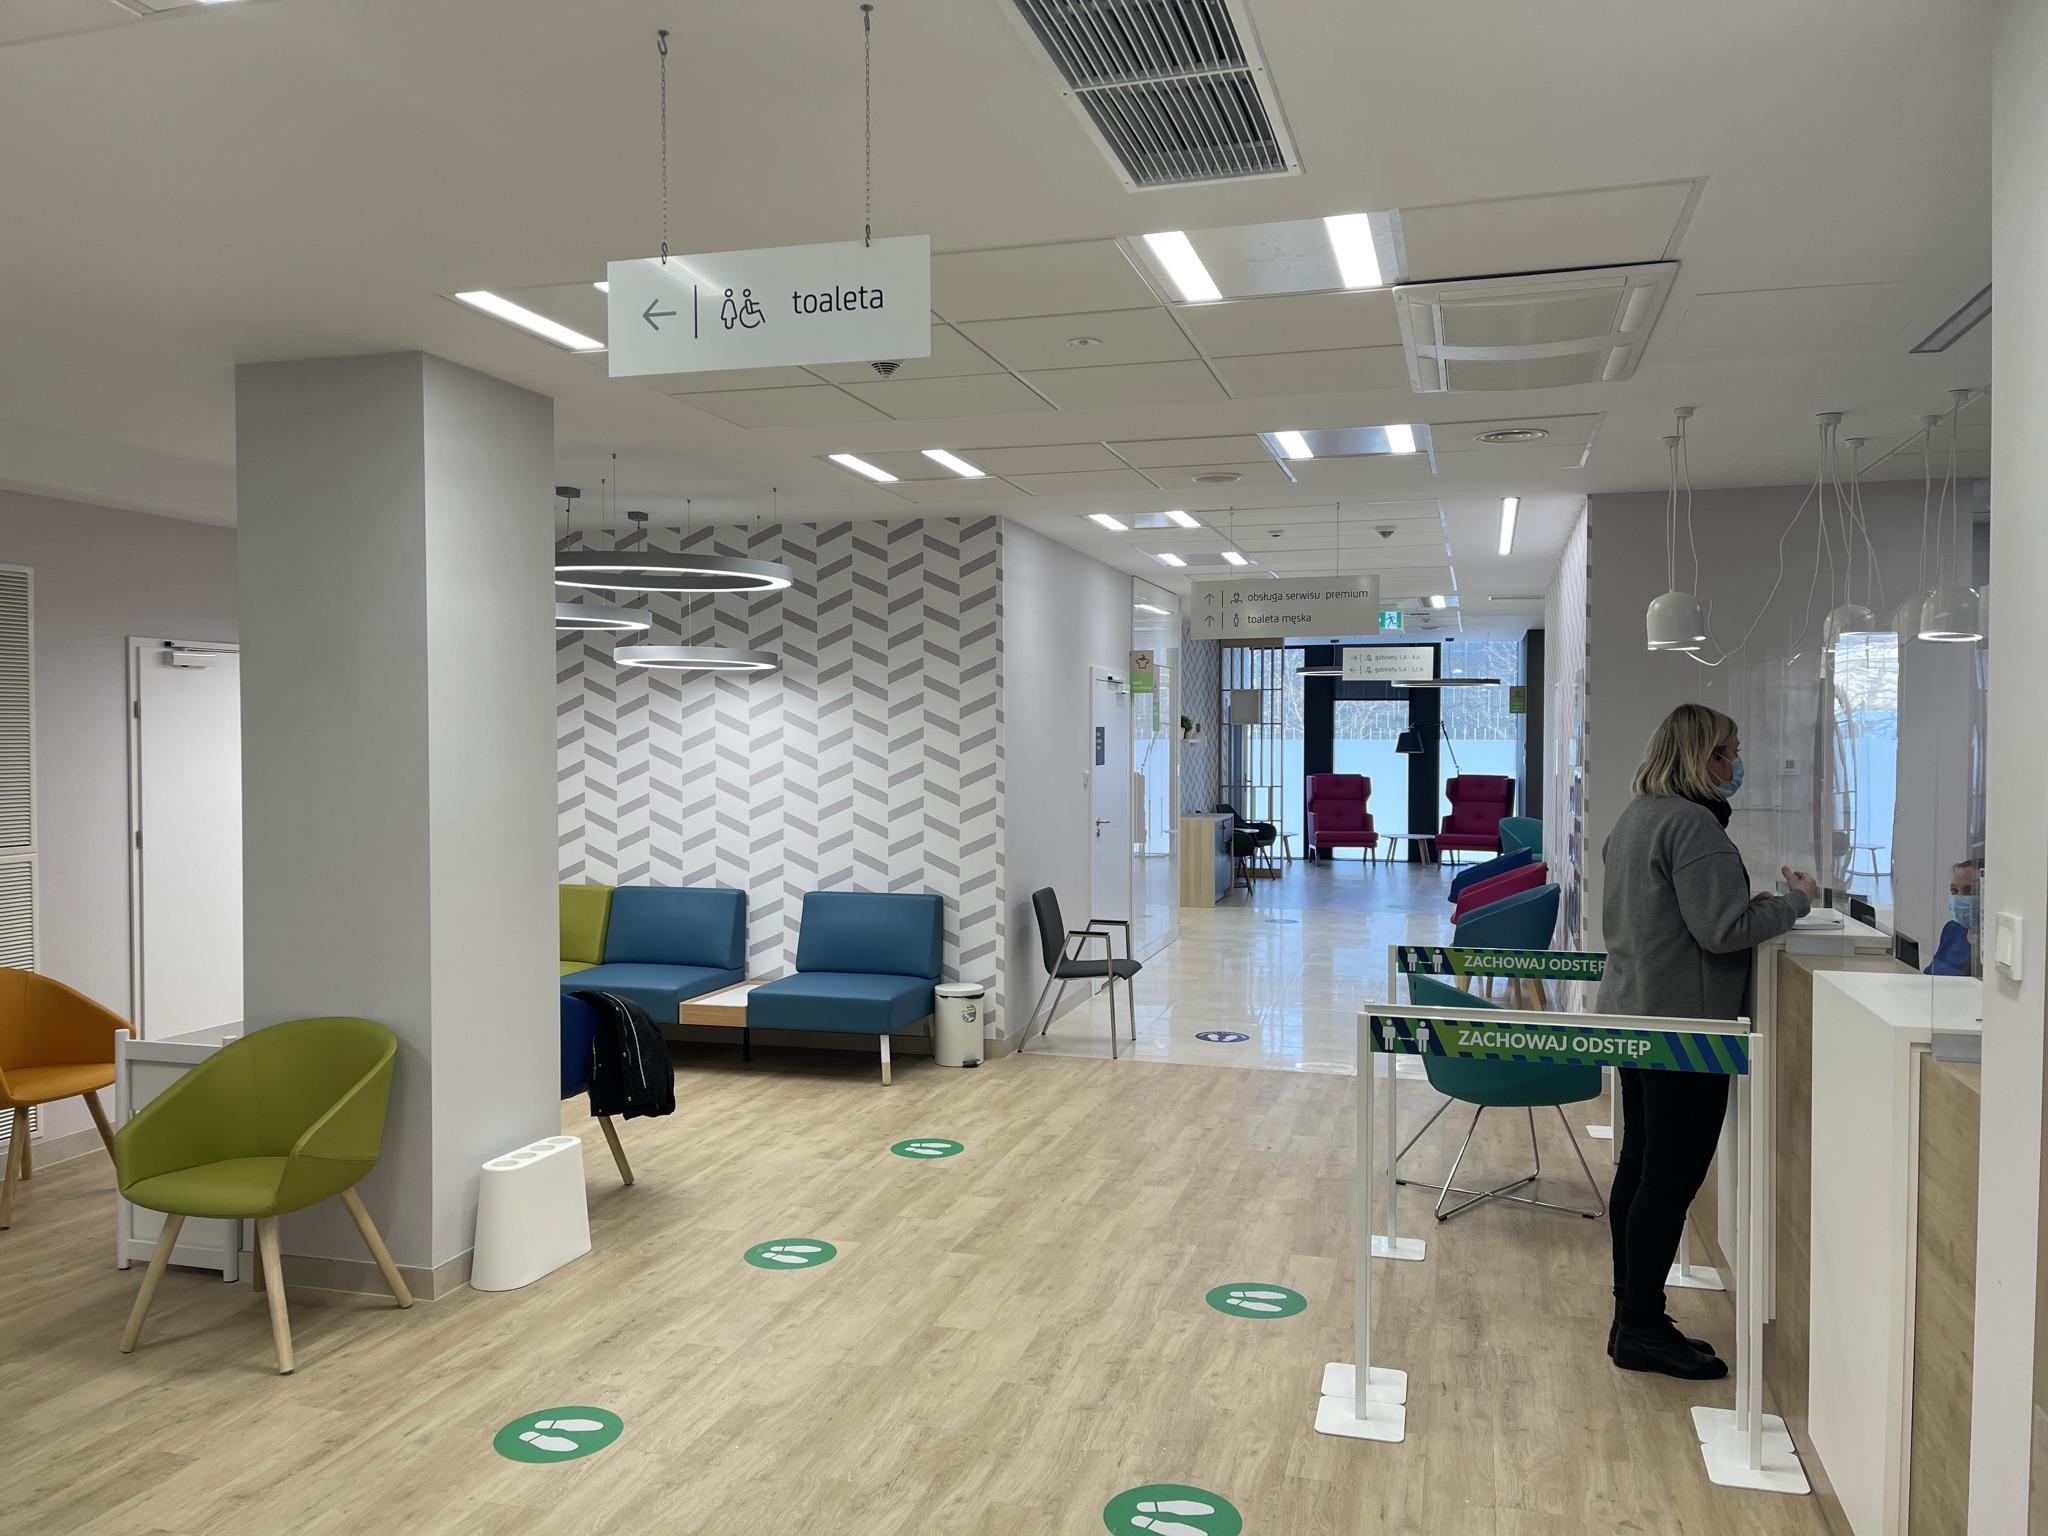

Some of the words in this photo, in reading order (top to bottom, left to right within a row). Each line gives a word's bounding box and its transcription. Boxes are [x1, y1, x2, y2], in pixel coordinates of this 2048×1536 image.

[792, 285, 883, 314] toaleta
[1247, 592, 1283, 603] obsługa
[1285, 590, 1320, 601] serwisu
[1325, 589, 1369, 601] premium
[1247, 614, 1279, 624] toaleta
[1282, 614, 1312, 624] męska
[1464, 955, 1545, 971] ZACHOWAJ
[1549, 958, 1606, 974] ODSTĘP
[1458, 1030, 1568, 1051] ZACHOWAJ
[1572, 1036, 1652, 1058] ODSTĘP
